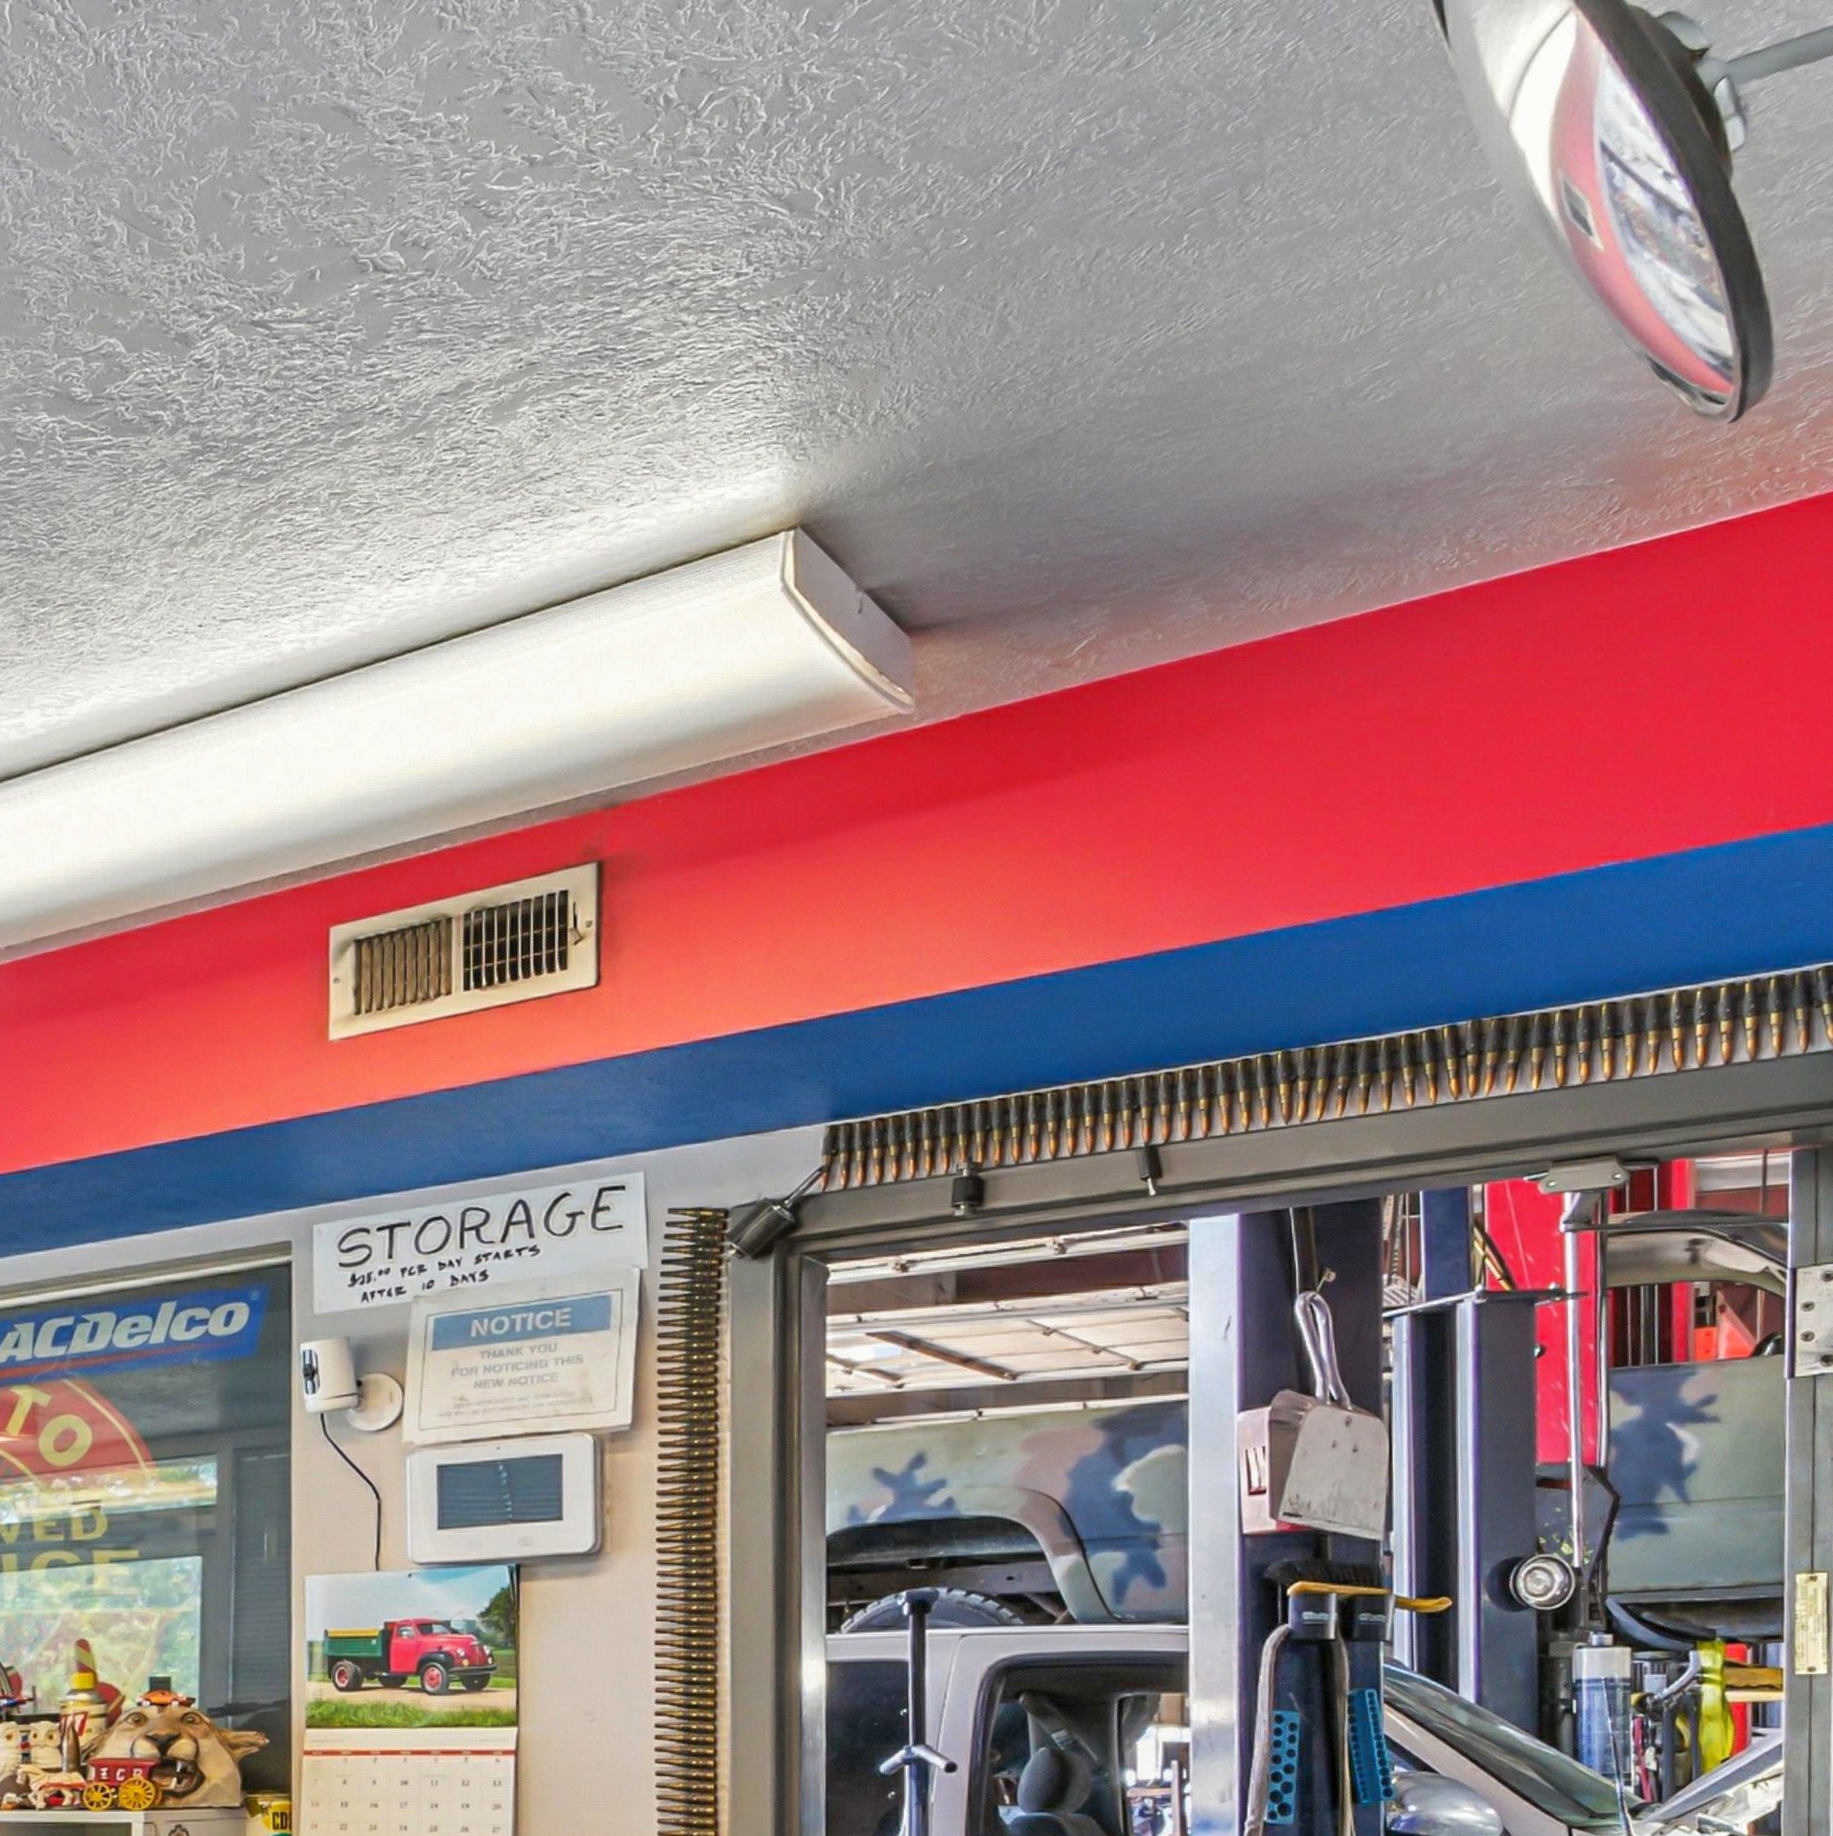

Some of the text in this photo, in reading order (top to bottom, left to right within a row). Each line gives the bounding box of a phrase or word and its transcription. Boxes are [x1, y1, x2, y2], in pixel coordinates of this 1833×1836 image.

[337, 1184, 627, 1268] STORAGE
[438, 1258, 462, 1272] DAY
[474, 1245, 541, 1265] STARTS
[360, 1287, 407, 1303] AFTER
[450, 1270, 490, 1288] DAYS
[469, 1307, 573, 1338] NOTICE
[479, 1343, 558, 1359] THANK YOU
[451, 1354, 584, 1378] FOR NOTICING THIS
[473, 1373, 560, 1390] NEW NOTICE
